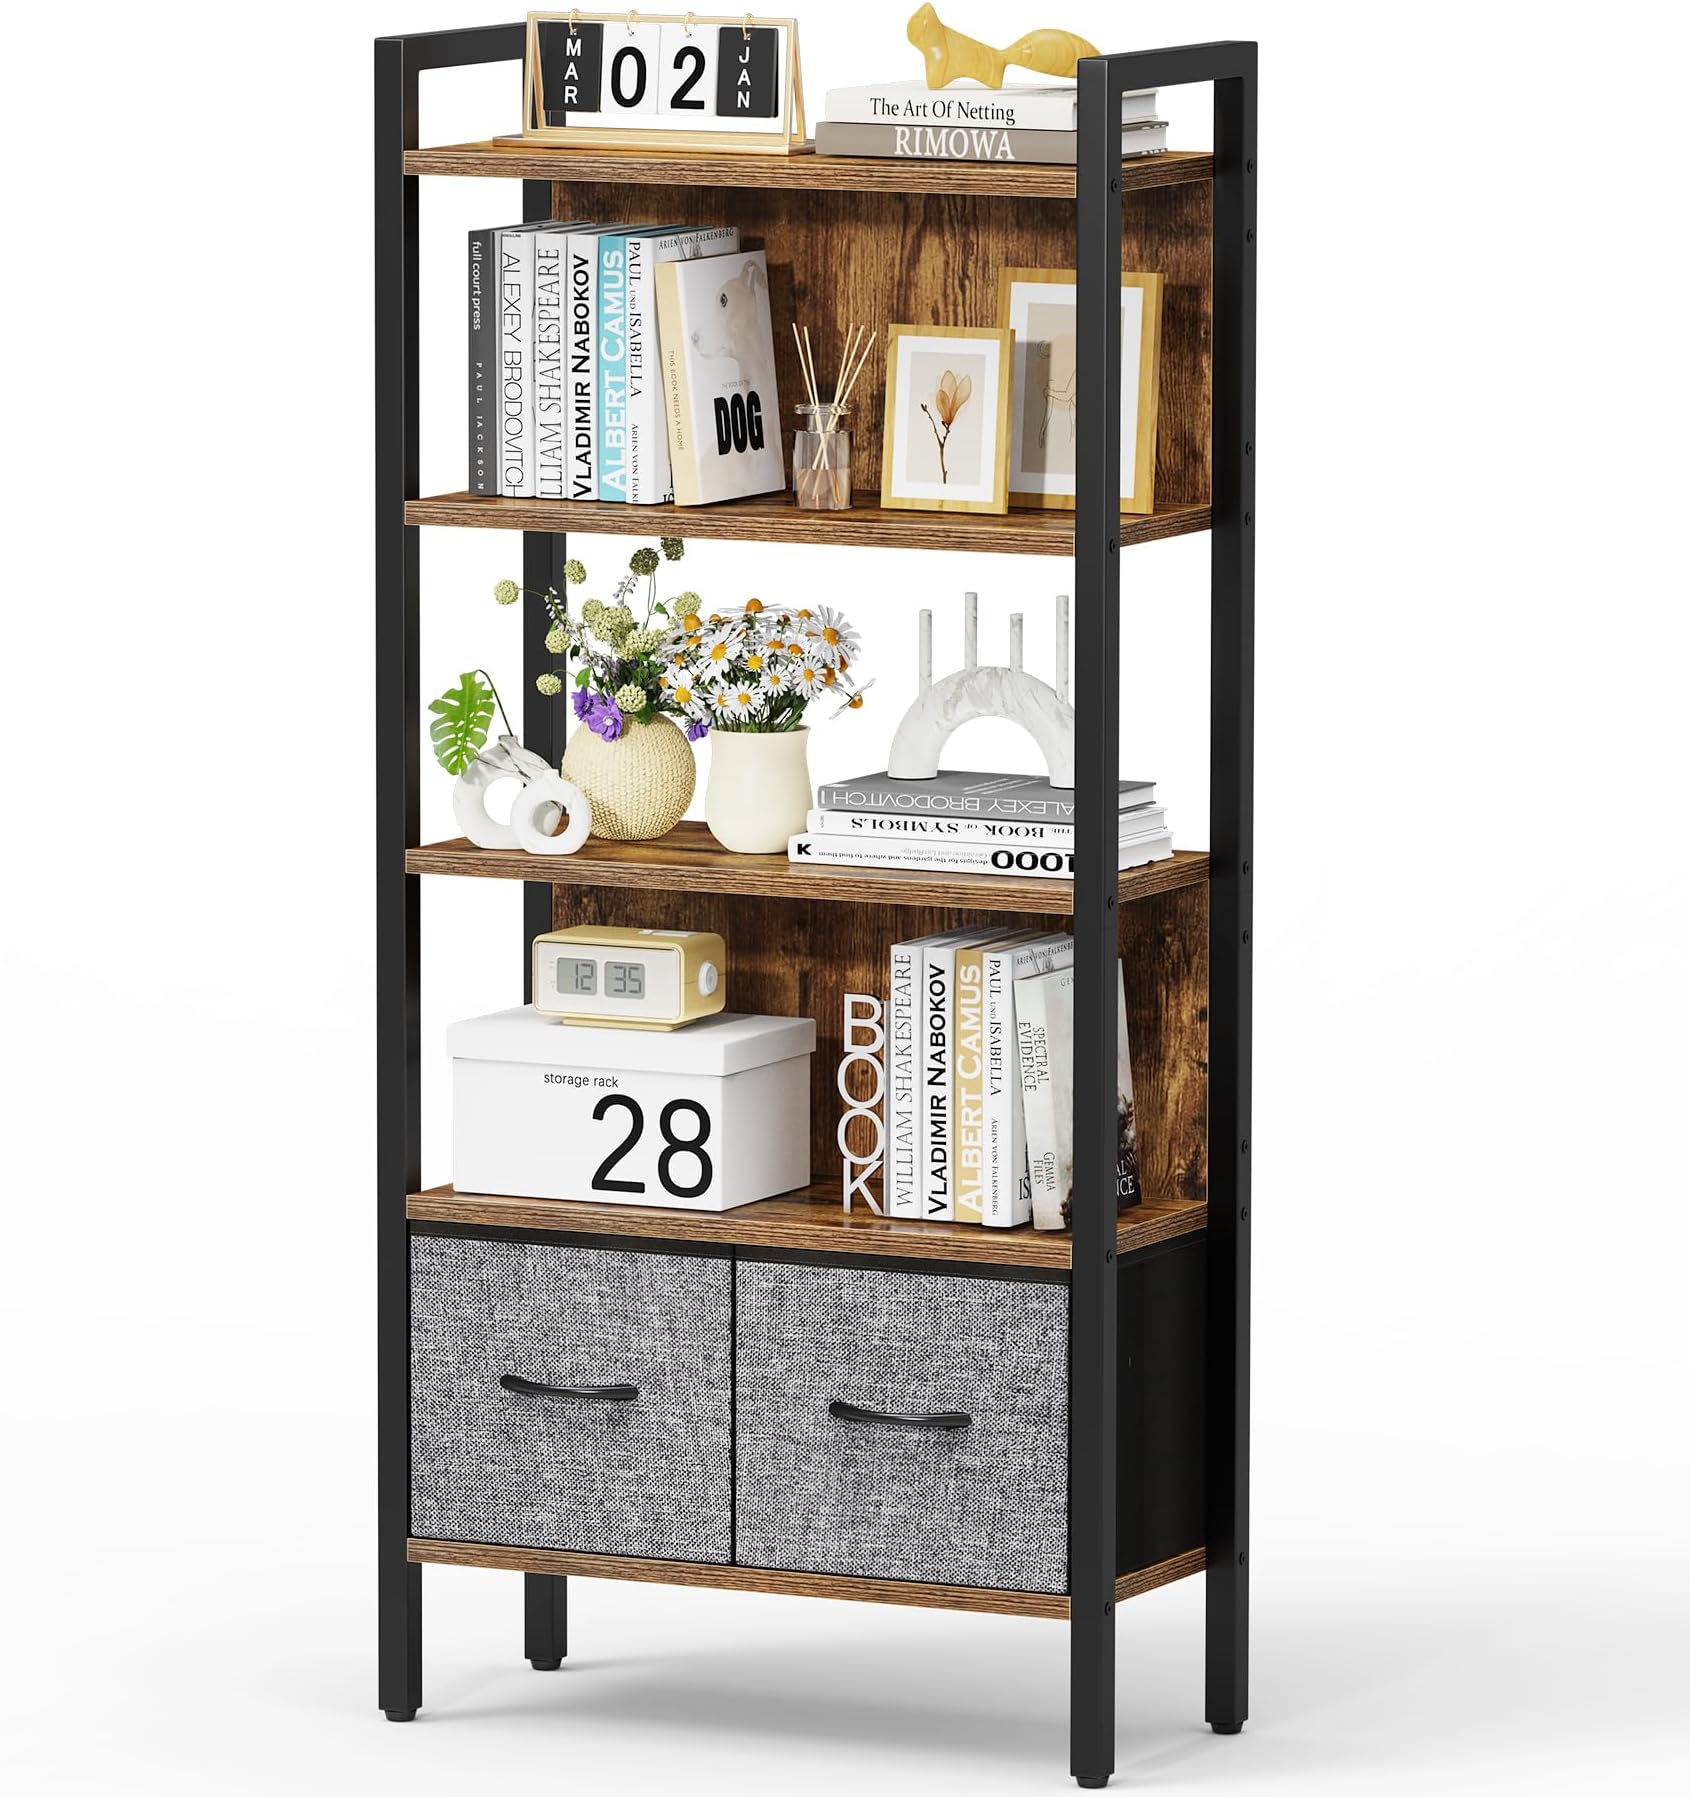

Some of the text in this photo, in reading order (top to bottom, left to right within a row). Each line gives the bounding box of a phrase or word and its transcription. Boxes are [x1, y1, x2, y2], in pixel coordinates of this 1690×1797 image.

[564, 38, 582, 104] MAR
[737, 46, 751, 108] JAN
[870, 97, 1016, 125] The Art Of Netting
[893, 126, 1016, 160] RIMOWA
[629, 241, 641, 287] PAUL
[659, 240, 678, 250] ARIEN
[694, 228, 734, 243] FALKENBERG
[472, 241, 482, 330] full court press
[503, 252, 522, 342] ALEXEY
[538, 249, 561, 413] SHAKESPEARE
[630, 312, 643, 398] ISABELLA
[669, 350, 677, 367] THIS
[571, 254, 592, 499] VLADIMIR NABOKOV
[601, 250, 626, 492] ALBERT CAMUS
[672, 393, 681, 418] NEEDS
[713, 391, 765, 456] DOG
[476, 415, 484, 490] JACKSON
[677, 428, 685, 451] HOME
[833, 790, 1075, 816] ALEXEY BRODOVITCH
[851, 817, 959, 833] SYMBOLS
[984, 824, 1044, 838] BOOK
[797, 843, 812, 856] K
[990, 850, 1075, 877] 1000
[575, 962, 642, 994] 12 35
[989, 959, 1001, 999] PAUL
[543, 1072, 618, 1088] storage rack
[895, 954, 914, 1206] WILLIAM SHAKESPEARE
[990, 1022, 1002, 1096] ISABELLA
[1018, 1022, 1037, 1092] EVIDENCE
[1033, 1026, 1049, 1084] SPECTRAL
[837, 993, 885, 1216] BOOK
[927, 963, 947, 1215] VLADIMIR NABOKOV
[956, 964, 983, 1214] ALBERT CAMUS
[591, 1093, 713, 1198] 28
[991, 1118, 999, 1216] ARIEN VON FALKENBERG
[1033, 1160, 1044, 1185] FILES
[1043, 1151, 1056, 1192] GEMMA
